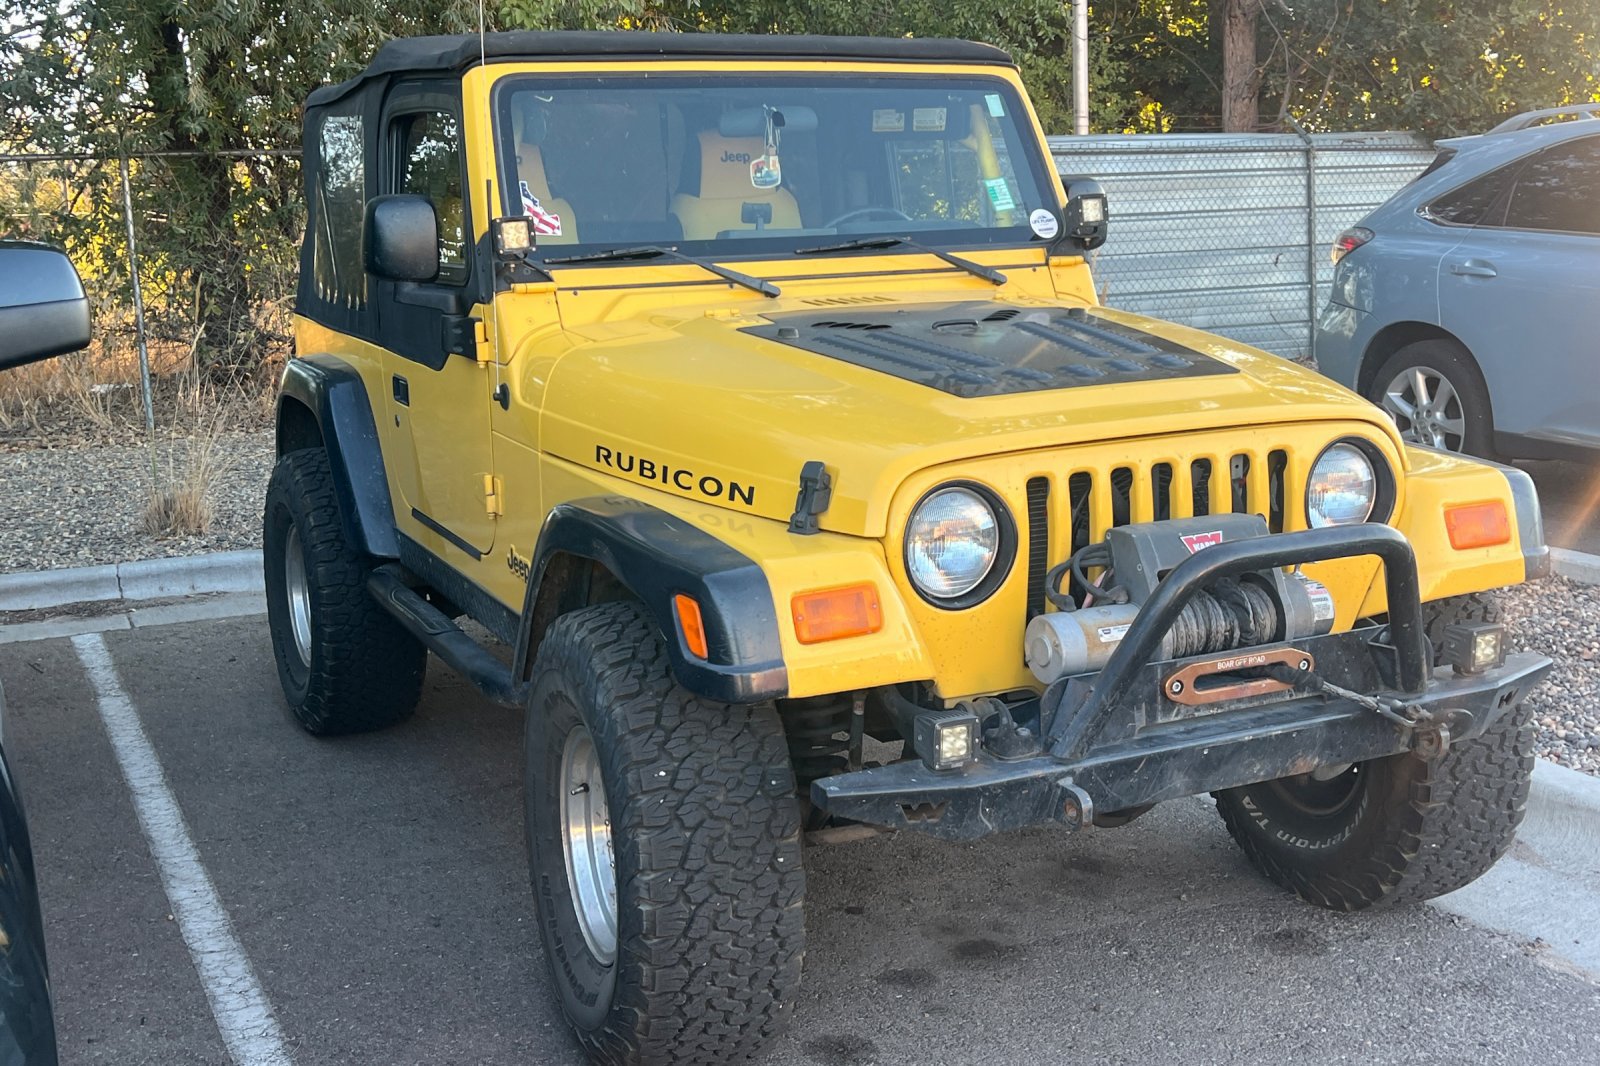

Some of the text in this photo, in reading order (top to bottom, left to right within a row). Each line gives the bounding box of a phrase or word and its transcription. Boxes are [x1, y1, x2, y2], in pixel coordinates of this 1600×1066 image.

[720, 150, 751, 165] Jeep
[595, 445, 755, 506] RUBICON
[507, 545, 530, 584] Jeep
[1217, 660, 1234, 670] BOAR
[1248, 655, 1266, 665] ROAD
[1242, 795, 1270, 831] T/A
